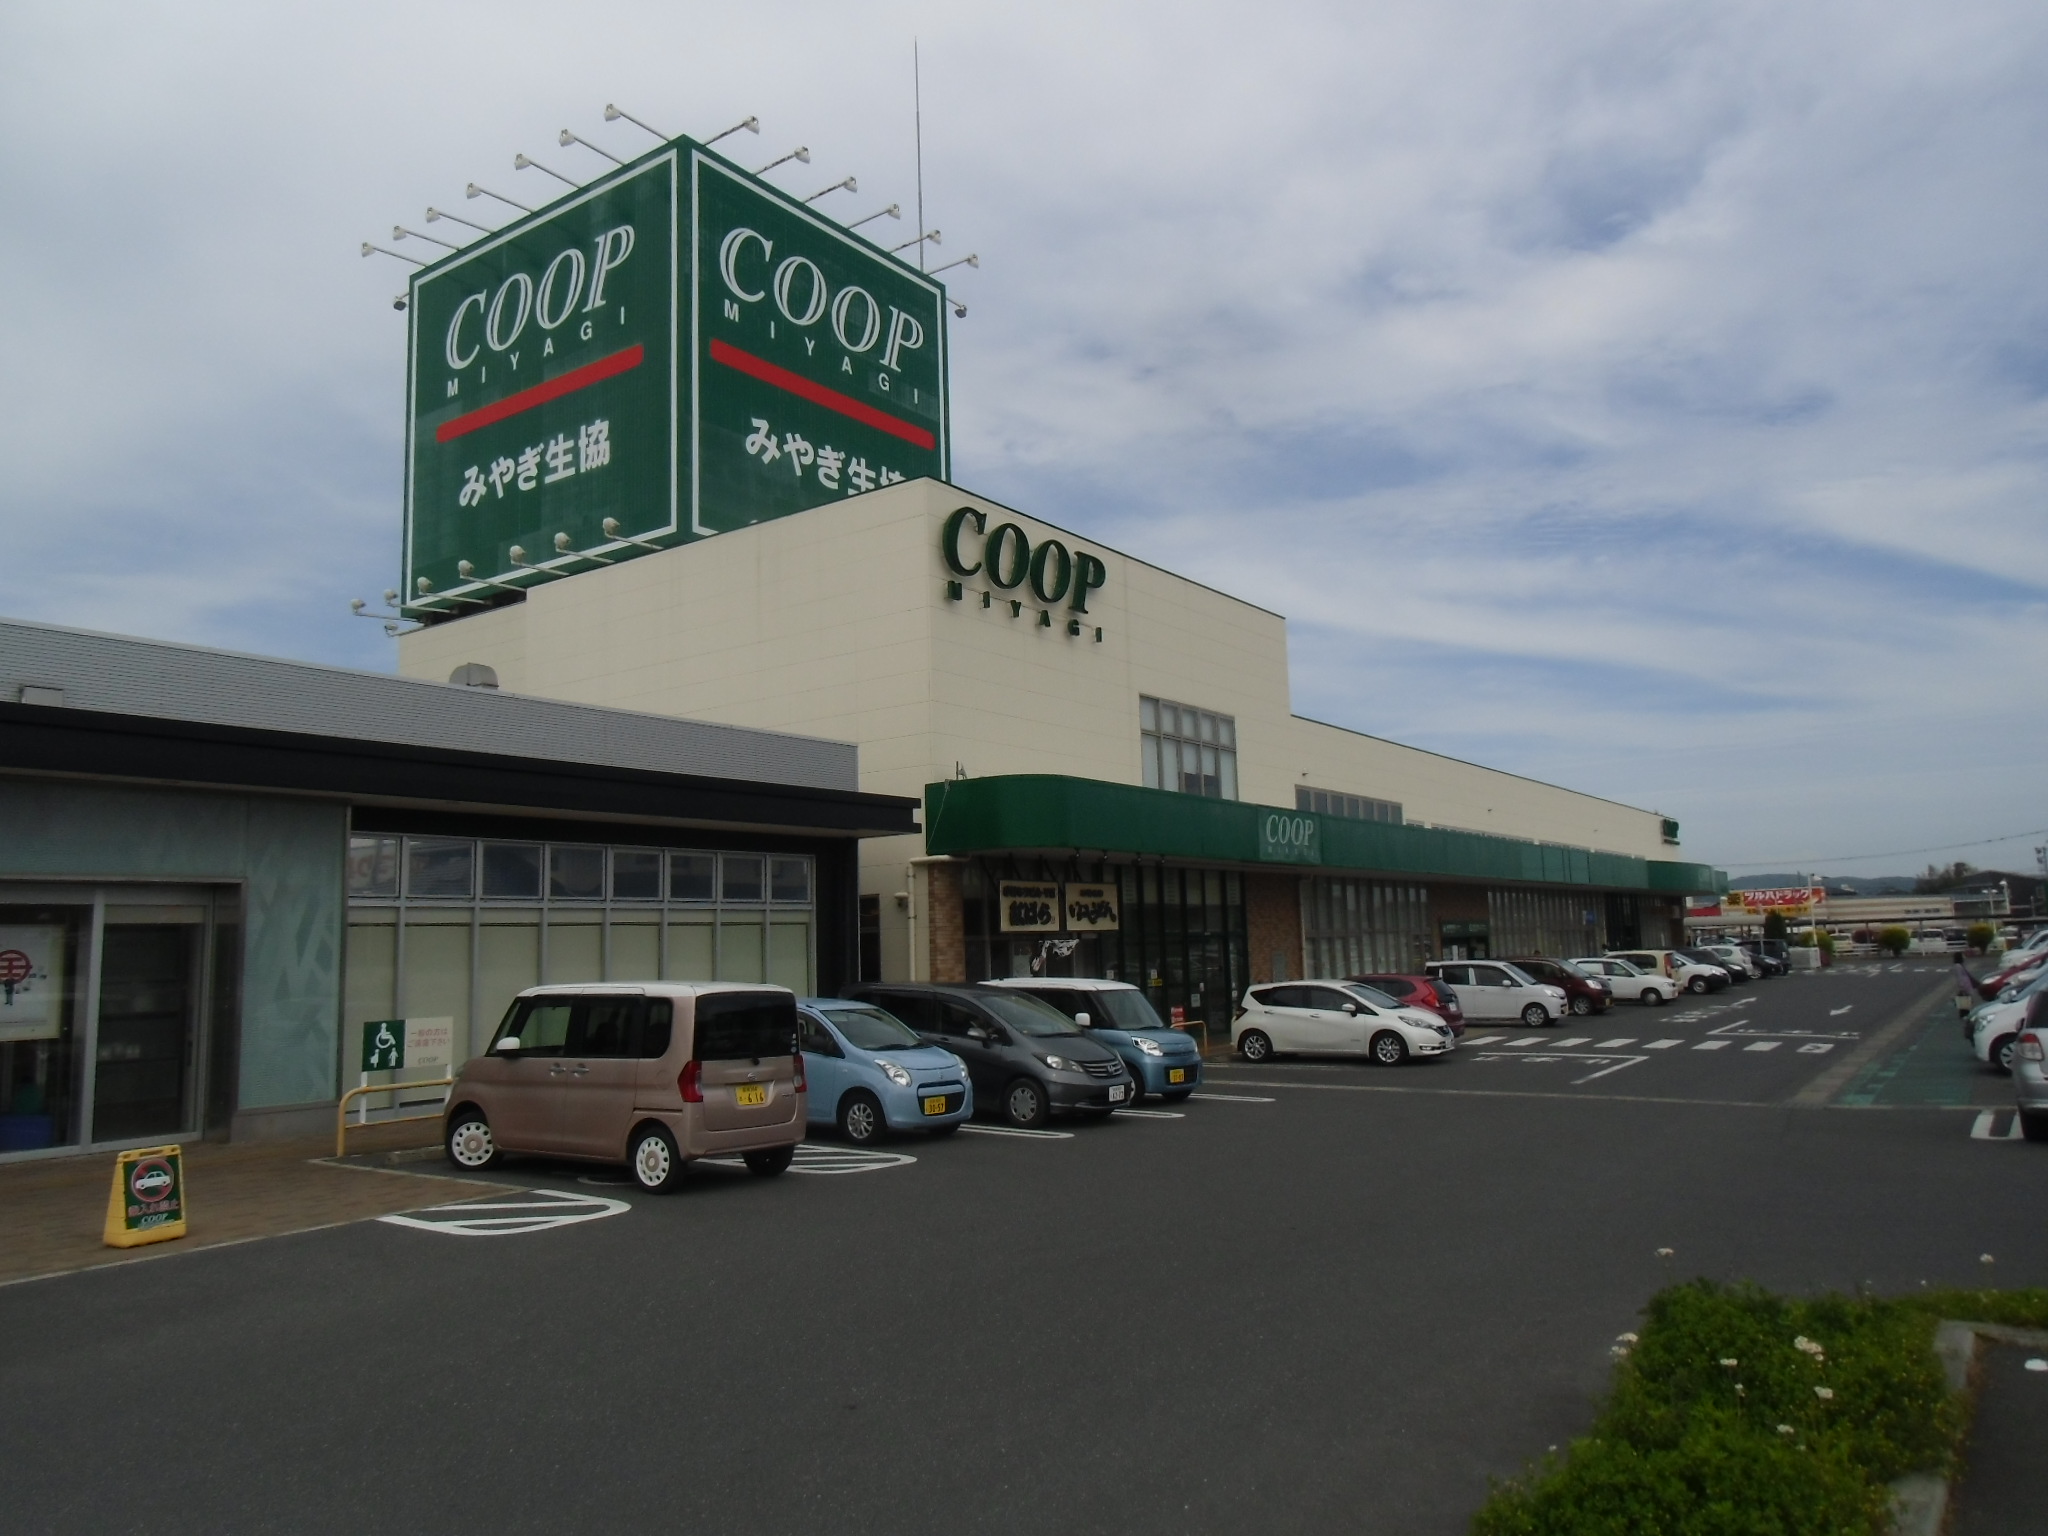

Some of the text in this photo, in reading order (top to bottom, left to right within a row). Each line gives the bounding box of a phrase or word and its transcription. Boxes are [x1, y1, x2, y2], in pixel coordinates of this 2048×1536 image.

[446, 225, 635, 370] COOP
[720, 227, 924, 372] COOP
[447, 306, 626, 398] MIYAGI
[724, 299, 918, 404] MIYAGI
[459, 419, 611, 507] みやぎ生協
[942, 506, 1106, 614] COOP
[947, 580, 1103, 643] MIYAGI
[1266, 814, 1314, 846] COOP
[141, 1212, 168, 1223] COOP
